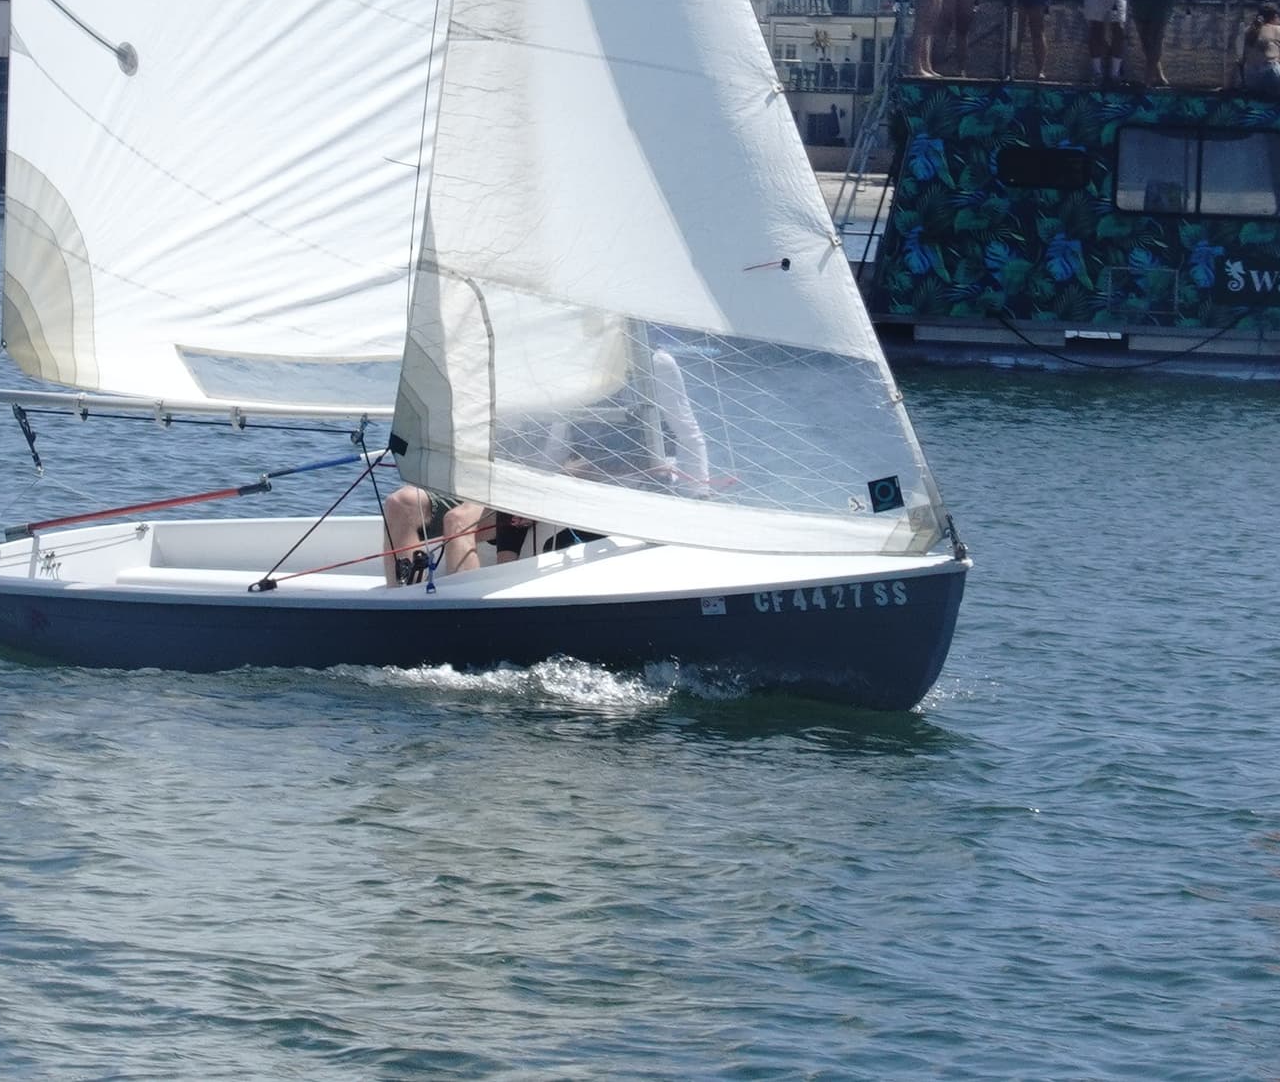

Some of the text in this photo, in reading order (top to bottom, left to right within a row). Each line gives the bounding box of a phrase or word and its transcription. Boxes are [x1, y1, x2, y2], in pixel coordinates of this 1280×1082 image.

[753, 590, 786, 613] CF
[792, 583, 863, 611] 4427
[872, 580, 908, 606] SS
